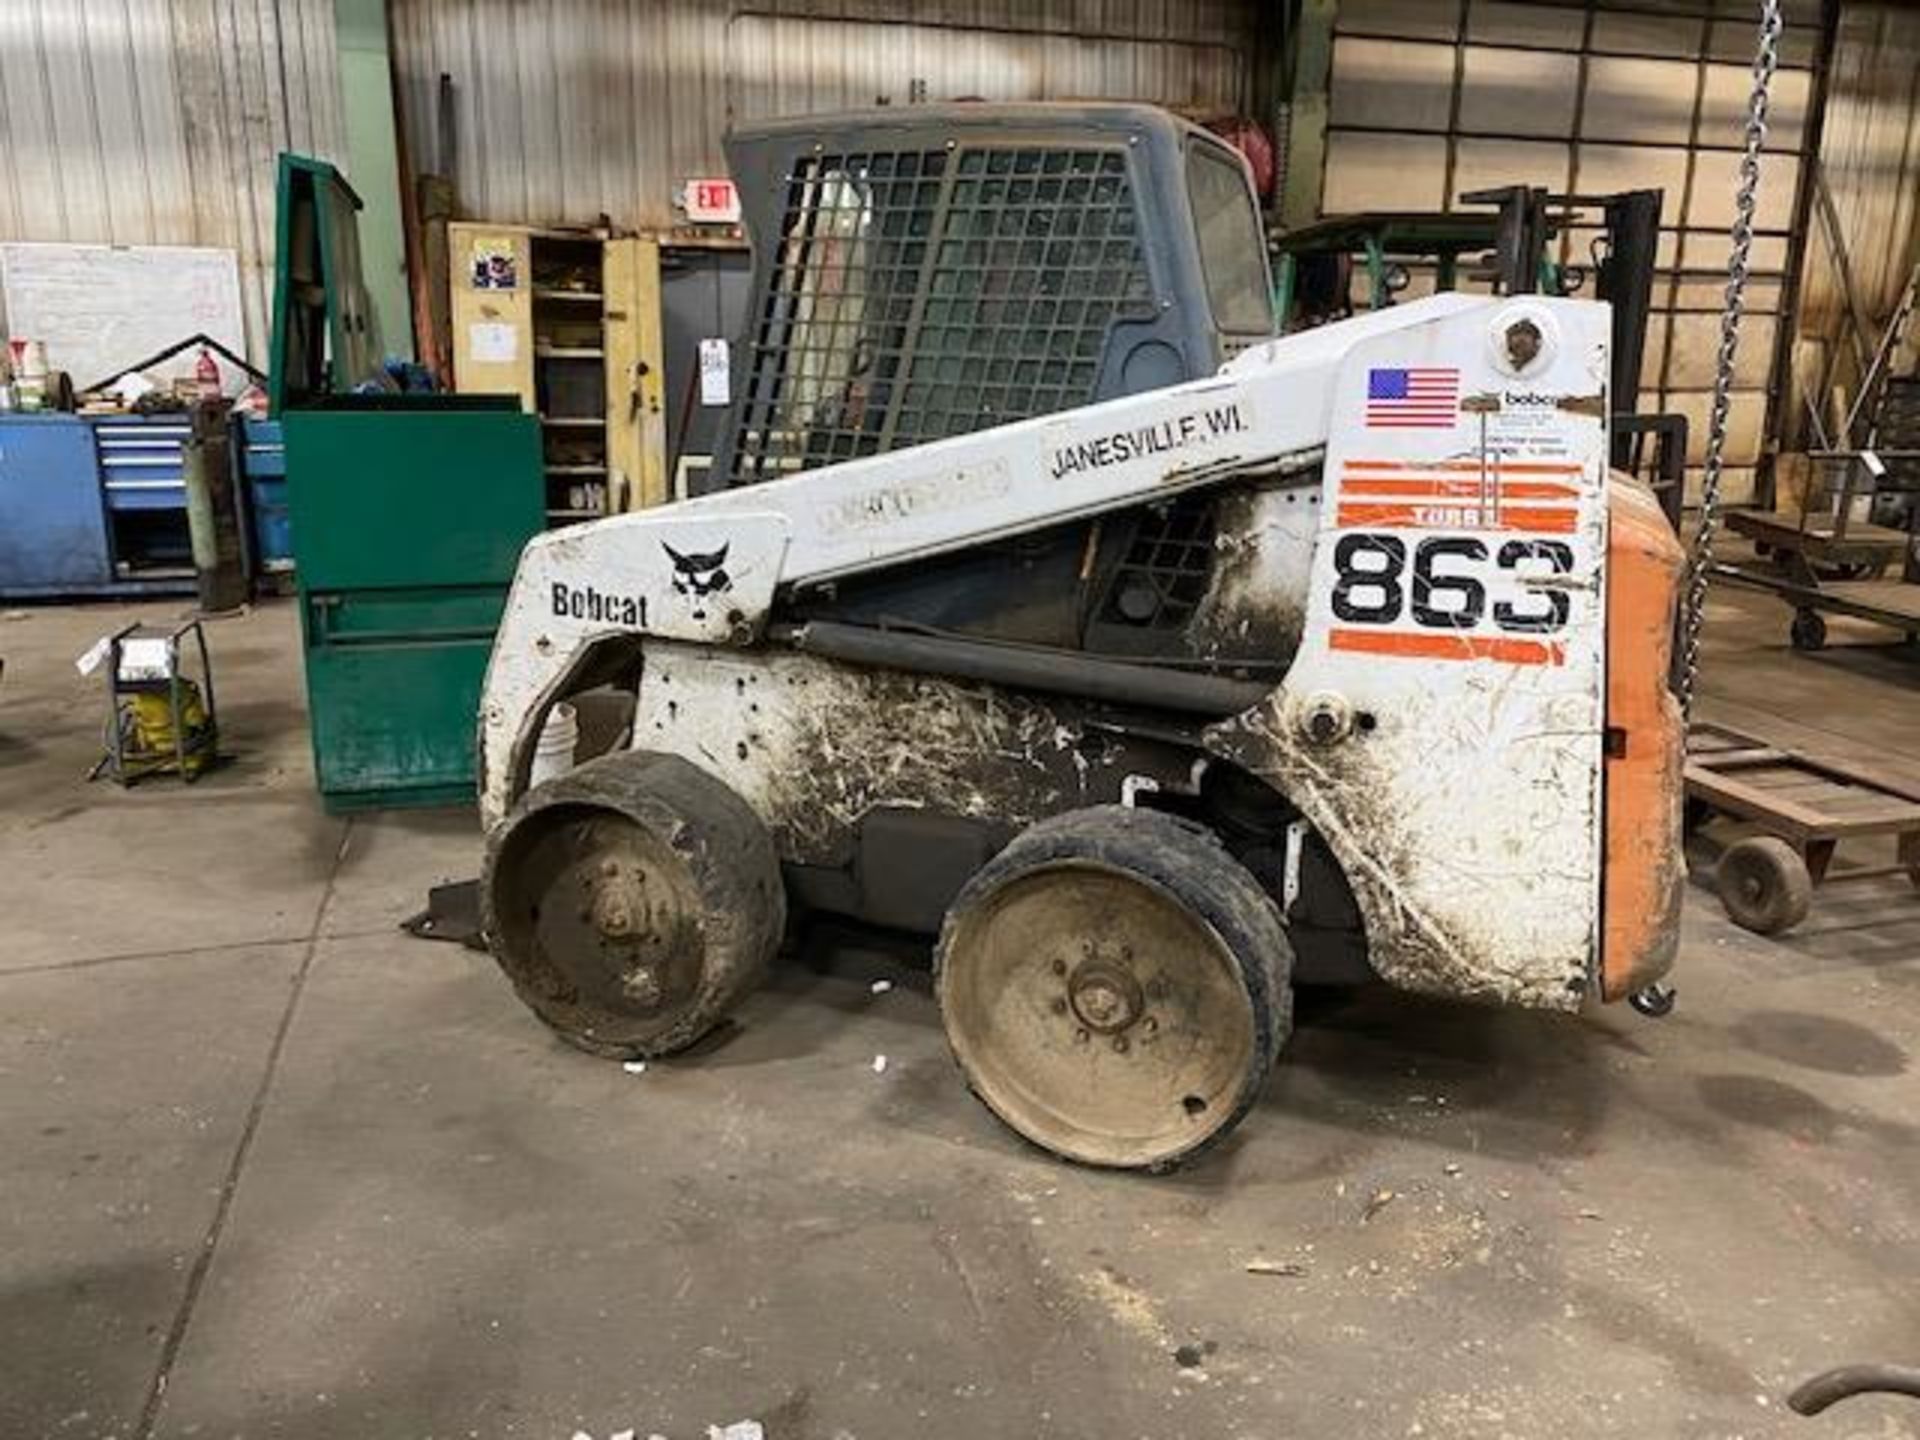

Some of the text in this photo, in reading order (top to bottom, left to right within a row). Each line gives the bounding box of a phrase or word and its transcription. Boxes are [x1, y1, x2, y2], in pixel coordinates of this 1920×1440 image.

[698, 185, 730, 210] EXIT
[551, 581, 649, 628] Bobcat
[1331, 533, 1575, 634] 863
